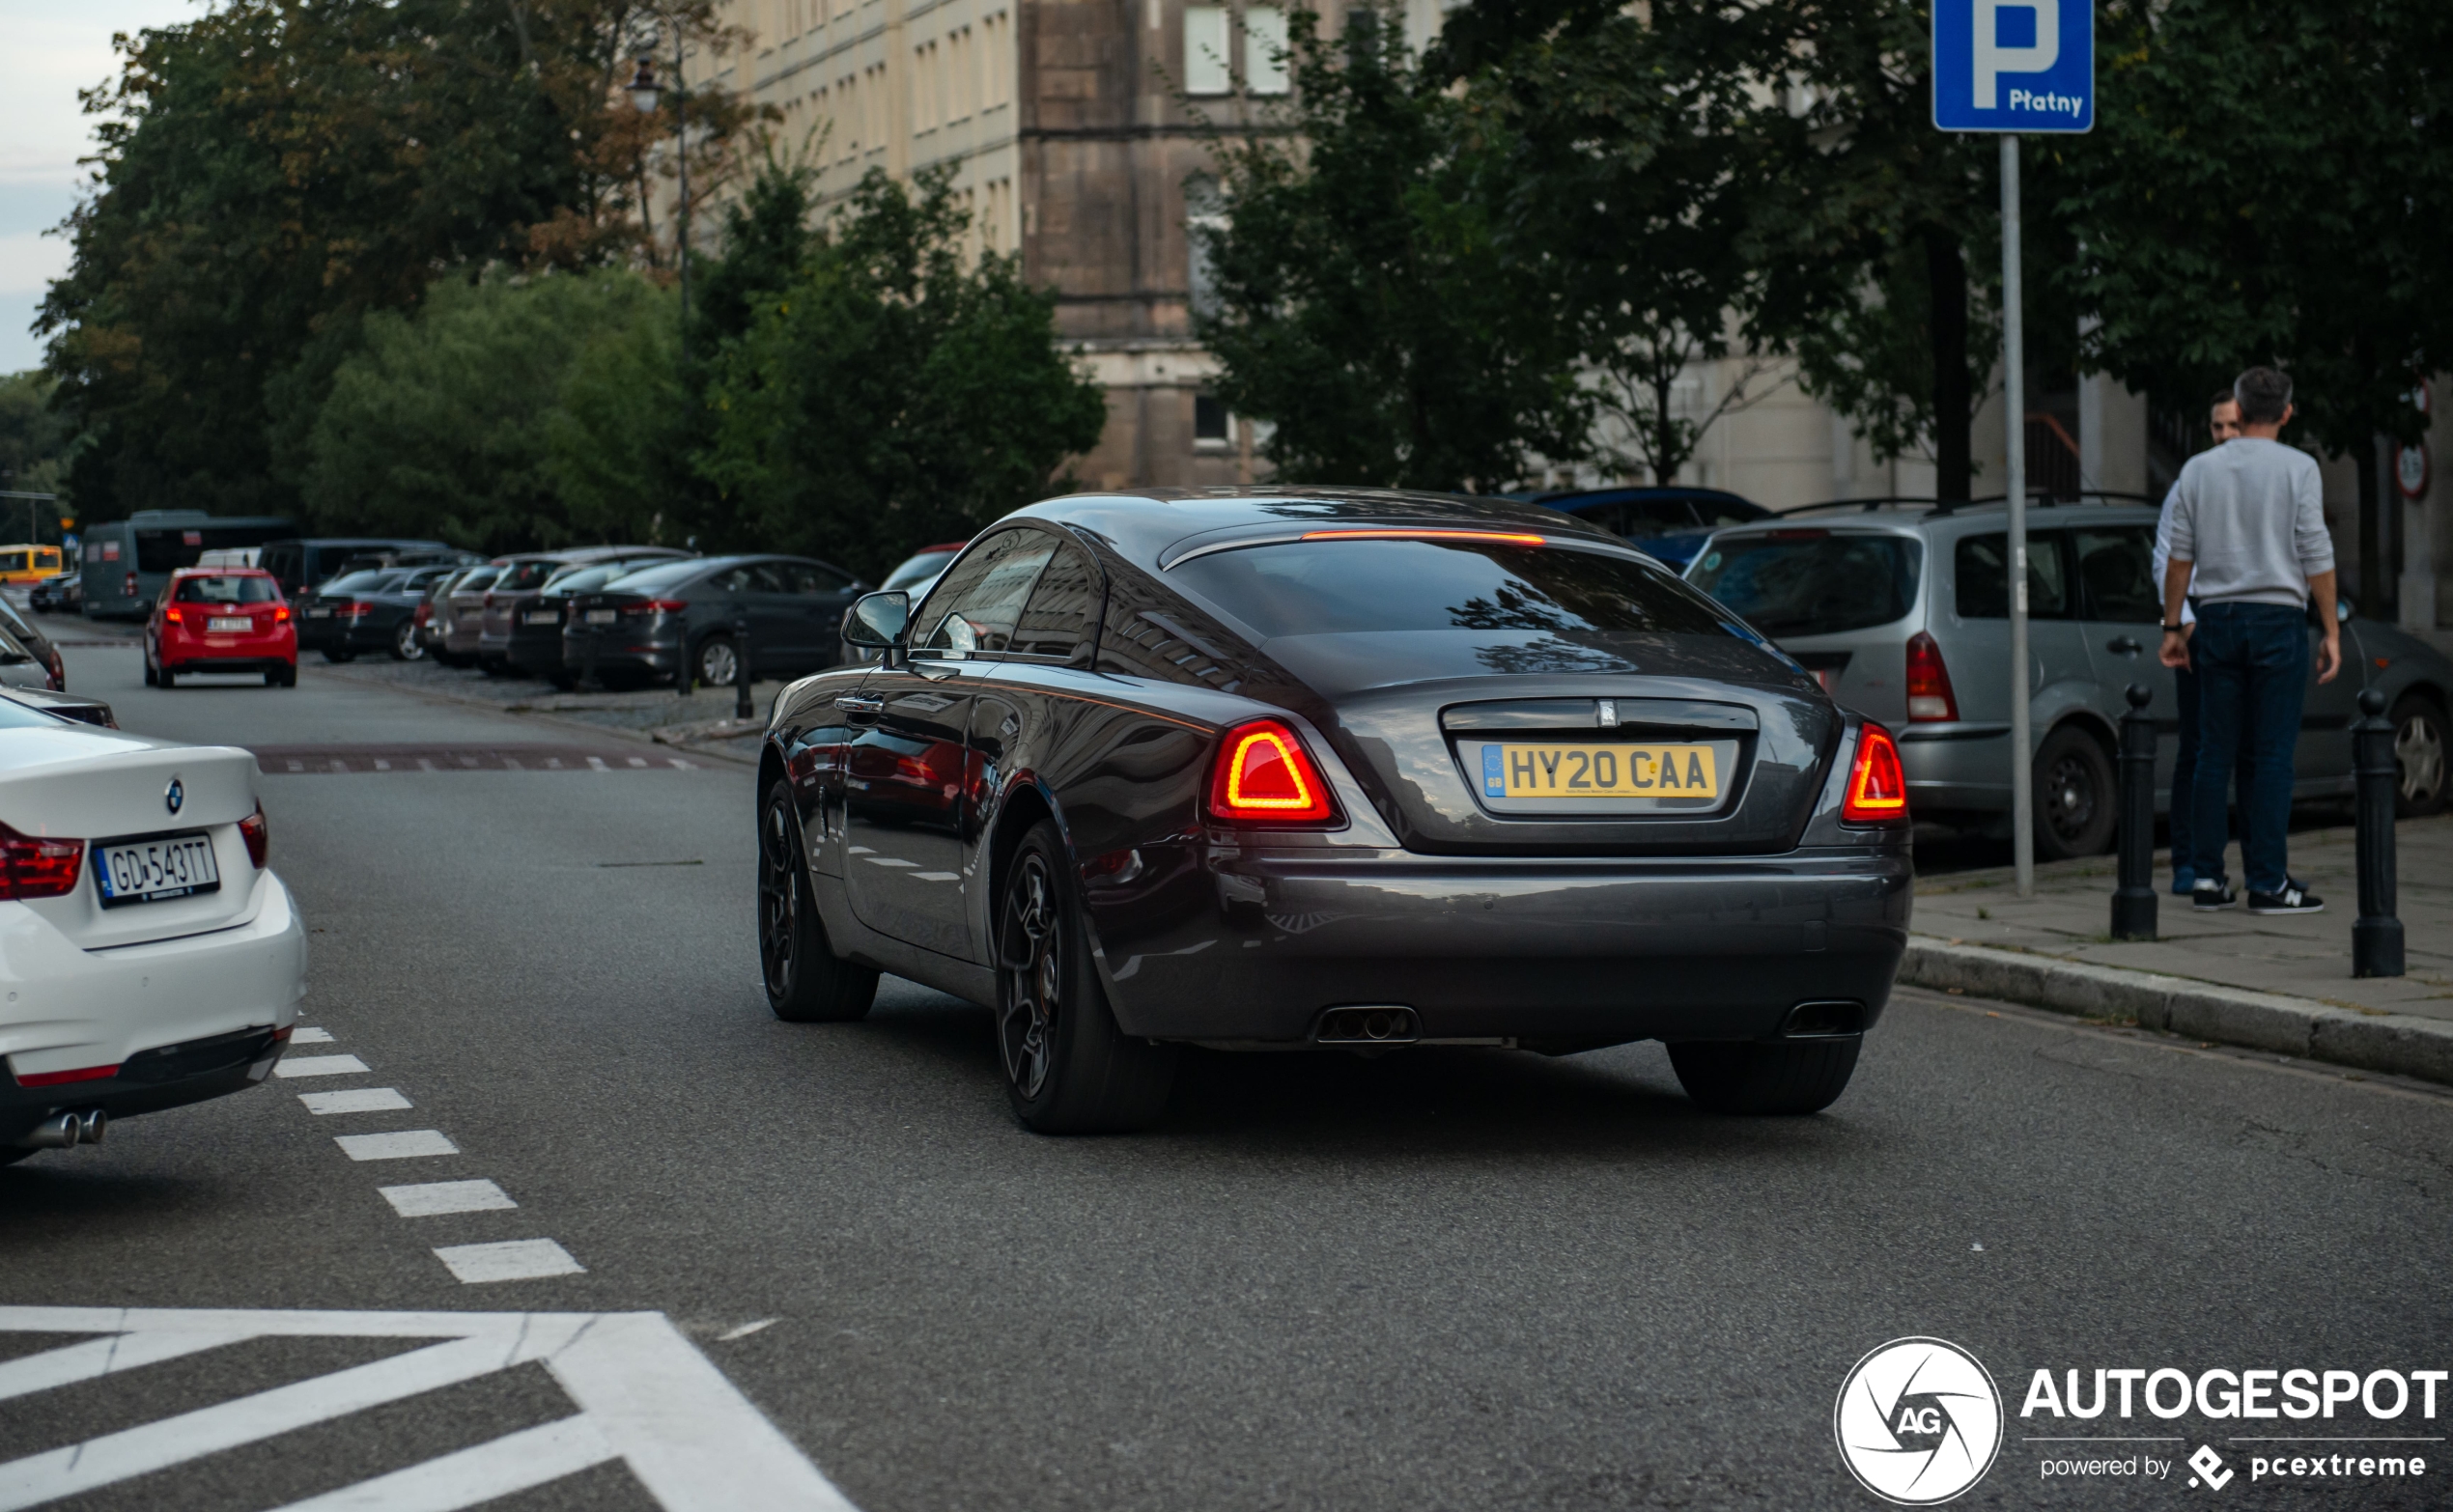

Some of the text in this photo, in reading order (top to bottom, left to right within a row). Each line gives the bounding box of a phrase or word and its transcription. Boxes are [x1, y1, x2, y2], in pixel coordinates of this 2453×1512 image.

[1973, 0, 2059, 109] P
[2010, 89, 2082, 118] Płatny
[1487, 777, 1503, 788] GB
[1511, 750, 1707, 789] HY20 CAA
[112, 842, 206, 891] GD 543TT
